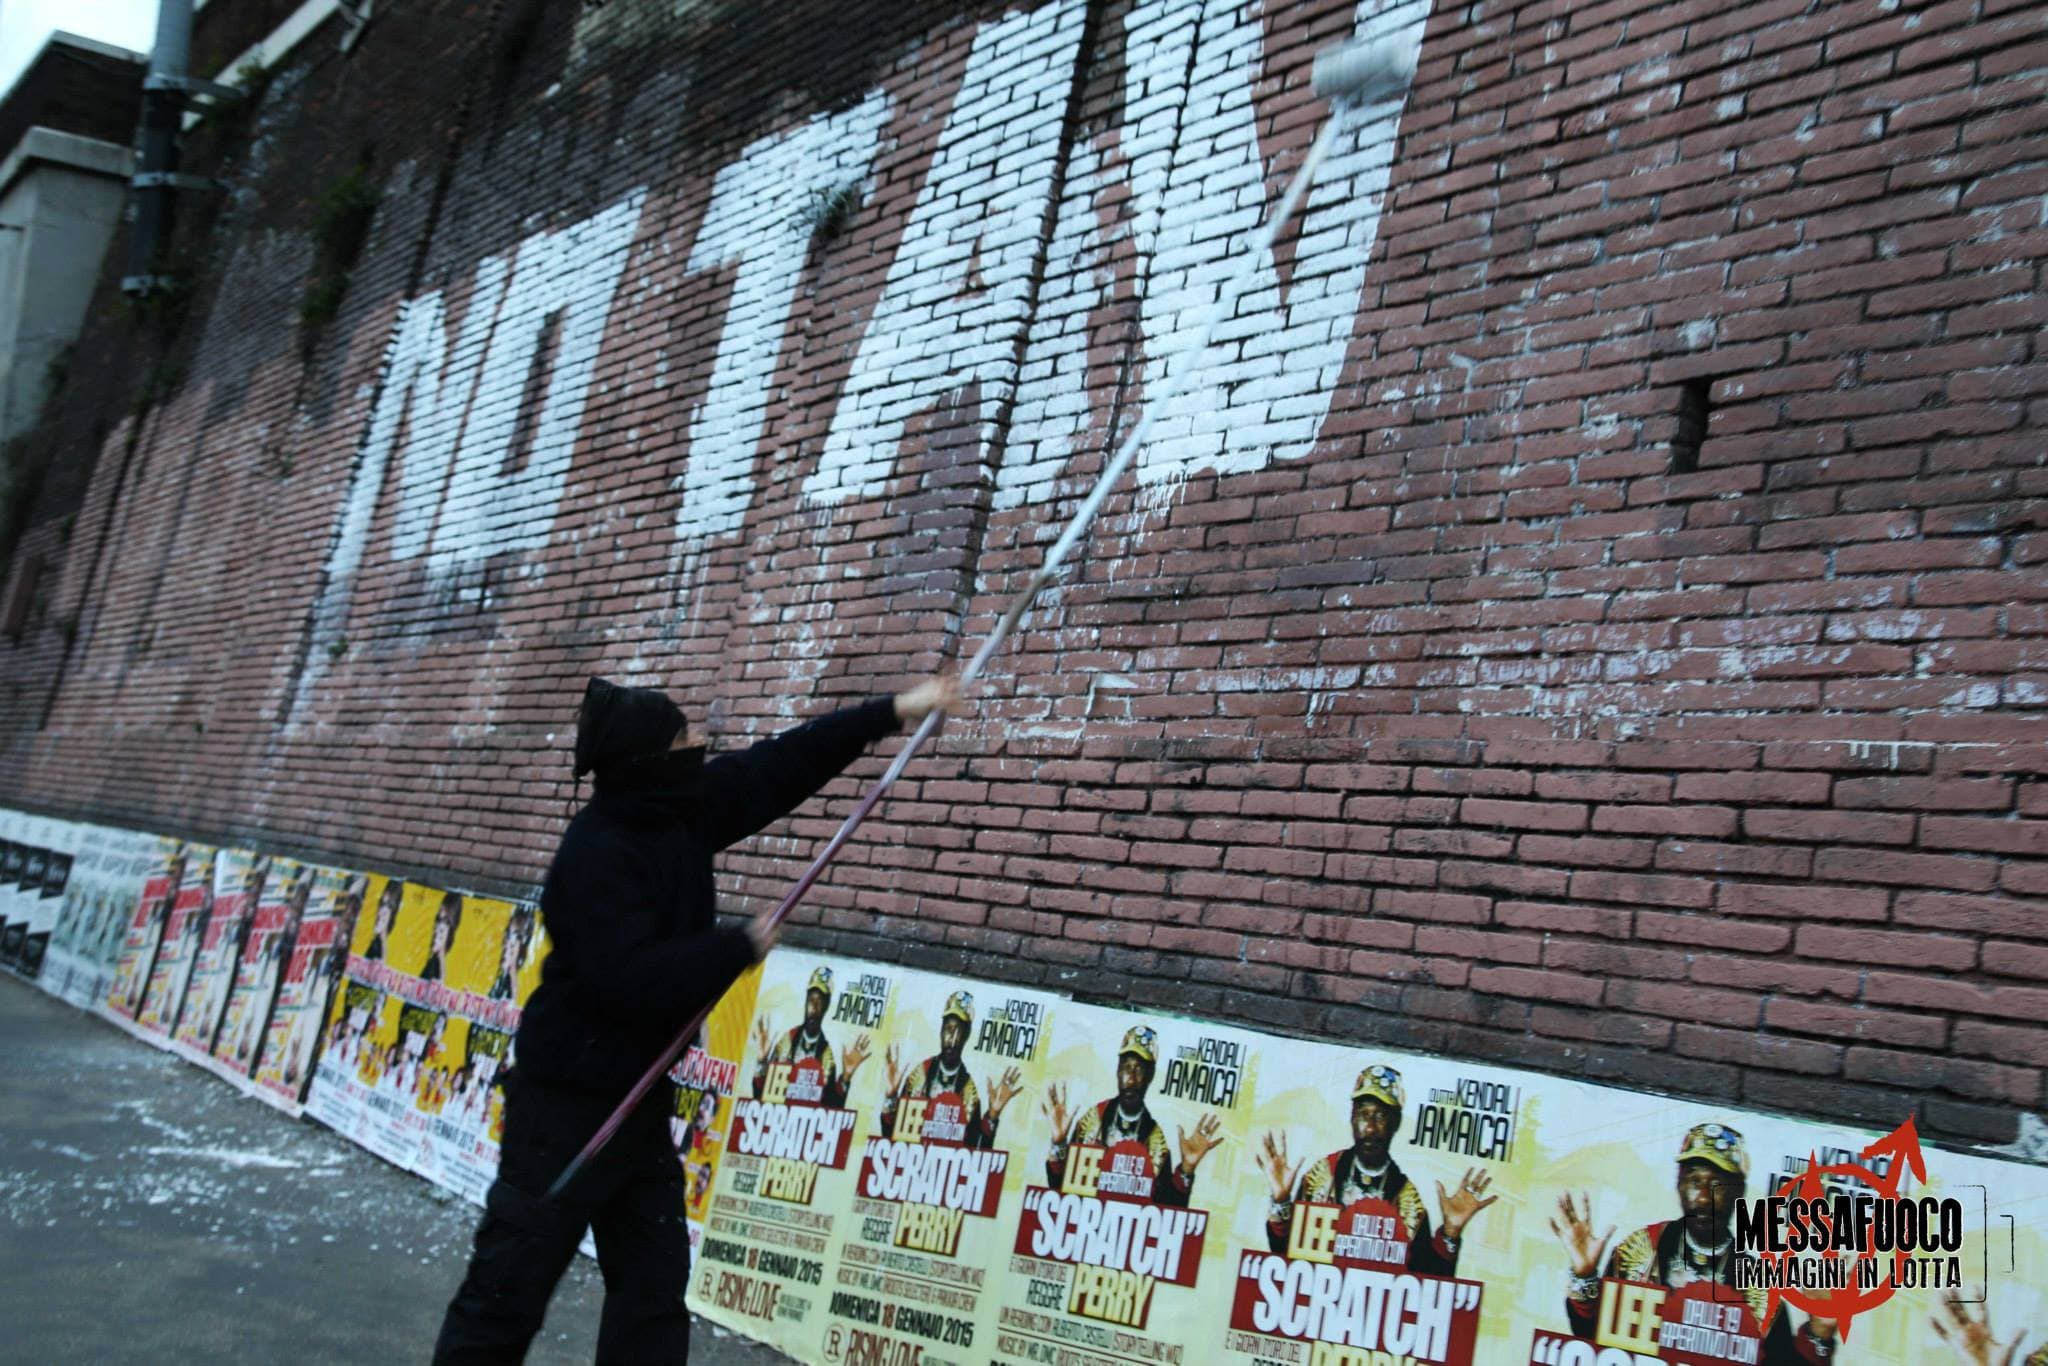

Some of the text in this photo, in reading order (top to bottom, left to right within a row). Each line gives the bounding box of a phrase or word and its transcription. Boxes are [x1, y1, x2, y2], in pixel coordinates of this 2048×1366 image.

[322, 0, 1428, 585] NO TAV
[832, 992, 884, 1029] JAMAICA
[1004, 999, 1039, 1025] KENDAL
[974, 1019, 1036, 1061] JAMAICA
[1196, 1037, 1240, 1068] KENDAL
[762, 1063, 793, 1103] LEE
[1160, 1059, 1237, 1109] JAMAICA
[1456, 1078, 1511, 1114] KENDAL
[892, 1098, 928, 1143] LEE
[1409, 1103, 1509, 1161] JAMAICA
[760, 1156, 819, 1204] PERRY
[1062, 1146, 1104, 1196] LEE
[895, 1201, 965, 1255] PERRY
[1287, 1203, 1341, 1264] LEE
[797, 1259, 824, 1286] 2015
[1068, 1263, 1155, 1327] PERRY
[1682, 1299, 1742, 1333] DALLE 19
[895, 1306, 944, 1340] GENNAIO
[942, 1317, 975, 1348] 2015
[1597, 1281, 1666, 1357] LEE
[1660, 1322, 1728, 1358] APERITIVO
[1730, 1336, 1759, 1365] CON
